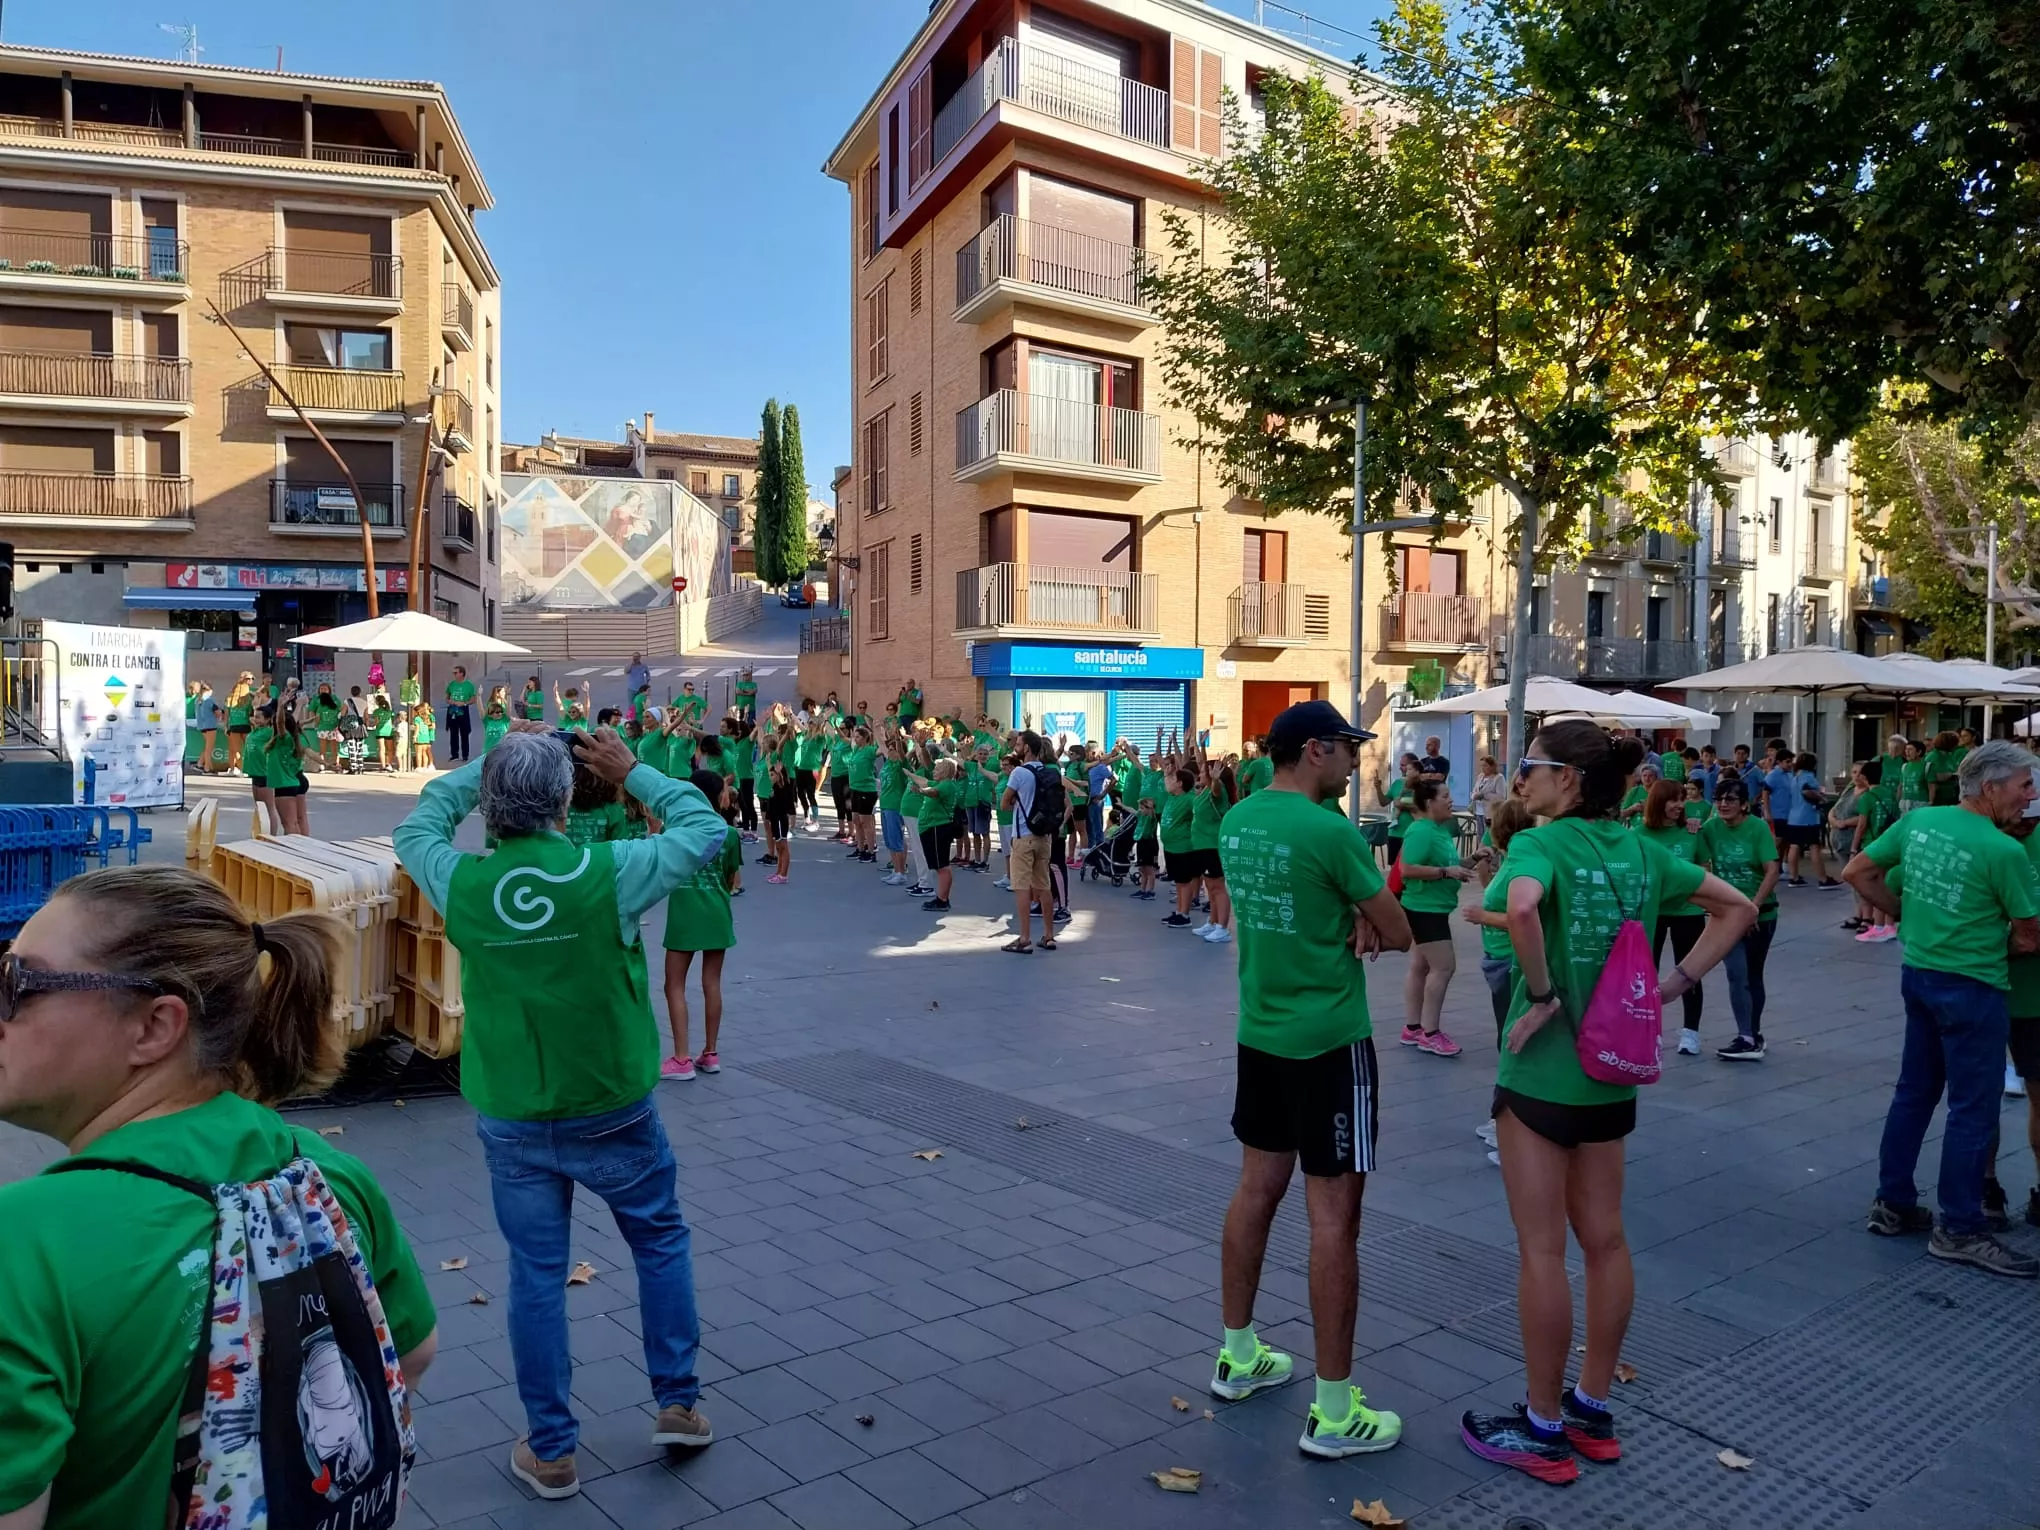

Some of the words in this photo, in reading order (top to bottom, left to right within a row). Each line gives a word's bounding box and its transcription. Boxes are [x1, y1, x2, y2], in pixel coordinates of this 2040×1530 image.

[97, 632, 143, 648] MARCHA
[70, 652, 109, 668] CONTRA
[112, 655, 122, 668] EL
[1074, 649, 1147, 665] santalucía
